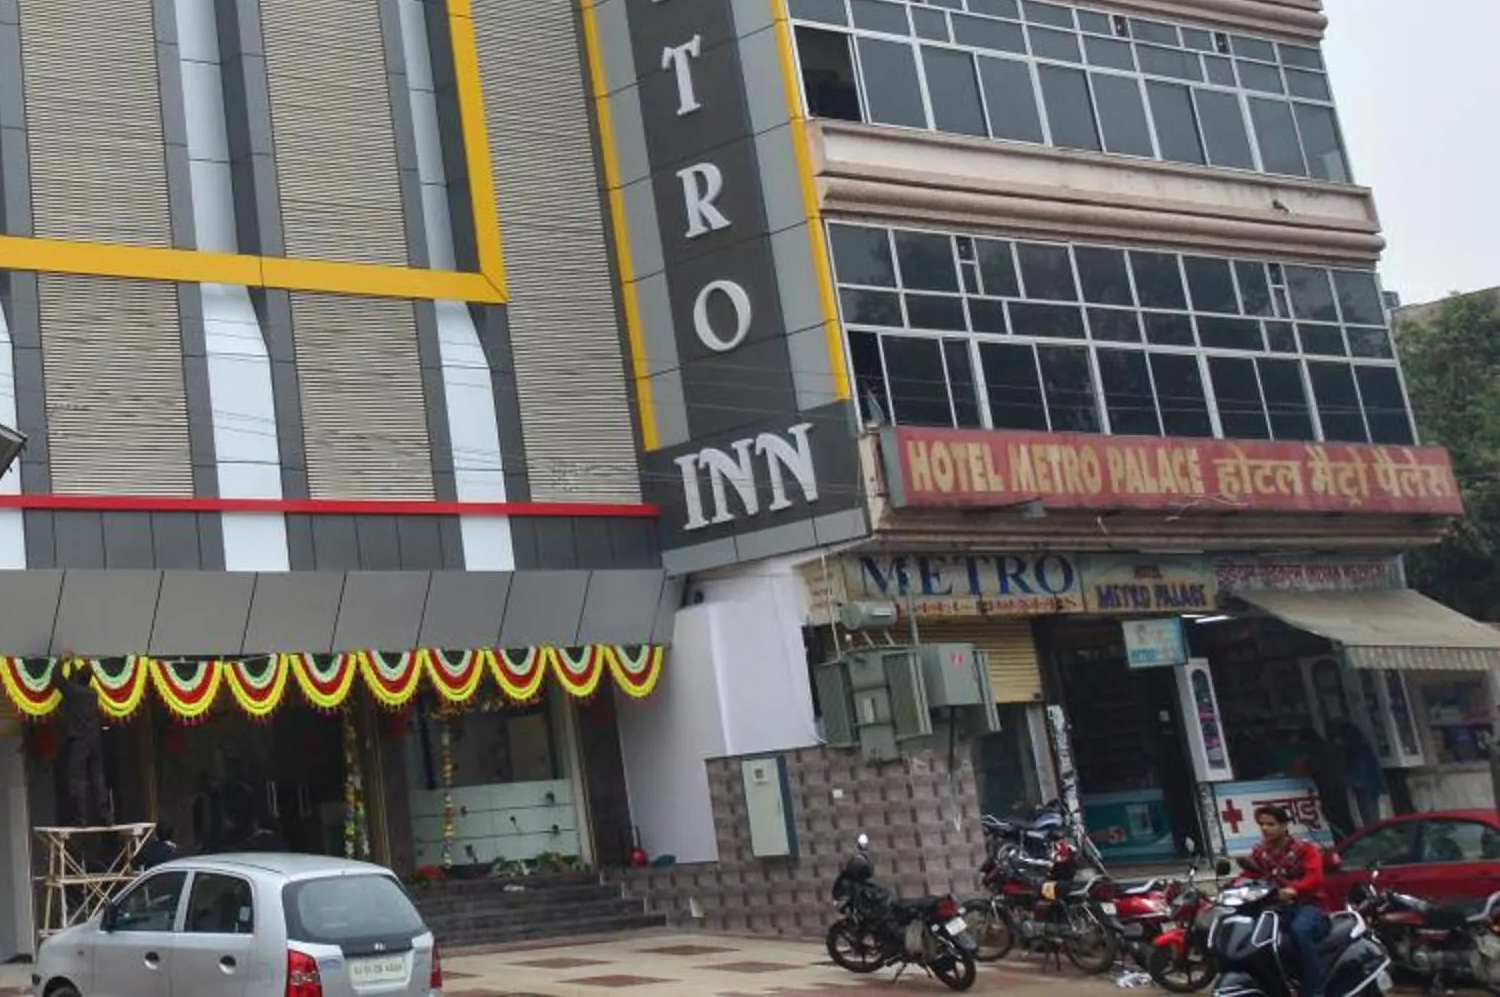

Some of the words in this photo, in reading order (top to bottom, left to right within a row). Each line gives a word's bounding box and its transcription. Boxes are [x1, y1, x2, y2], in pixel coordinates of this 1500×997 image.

[674, 423, 820, 531] INN
[906, 440, 1004, 493] HOTEL
[1008, 442, 1101, 494] METRO
[1105, 447, 1205, 495] PALACE
[1212, 447, 1303, 502] होटल
[858, 554, 1075, 597] METRO
